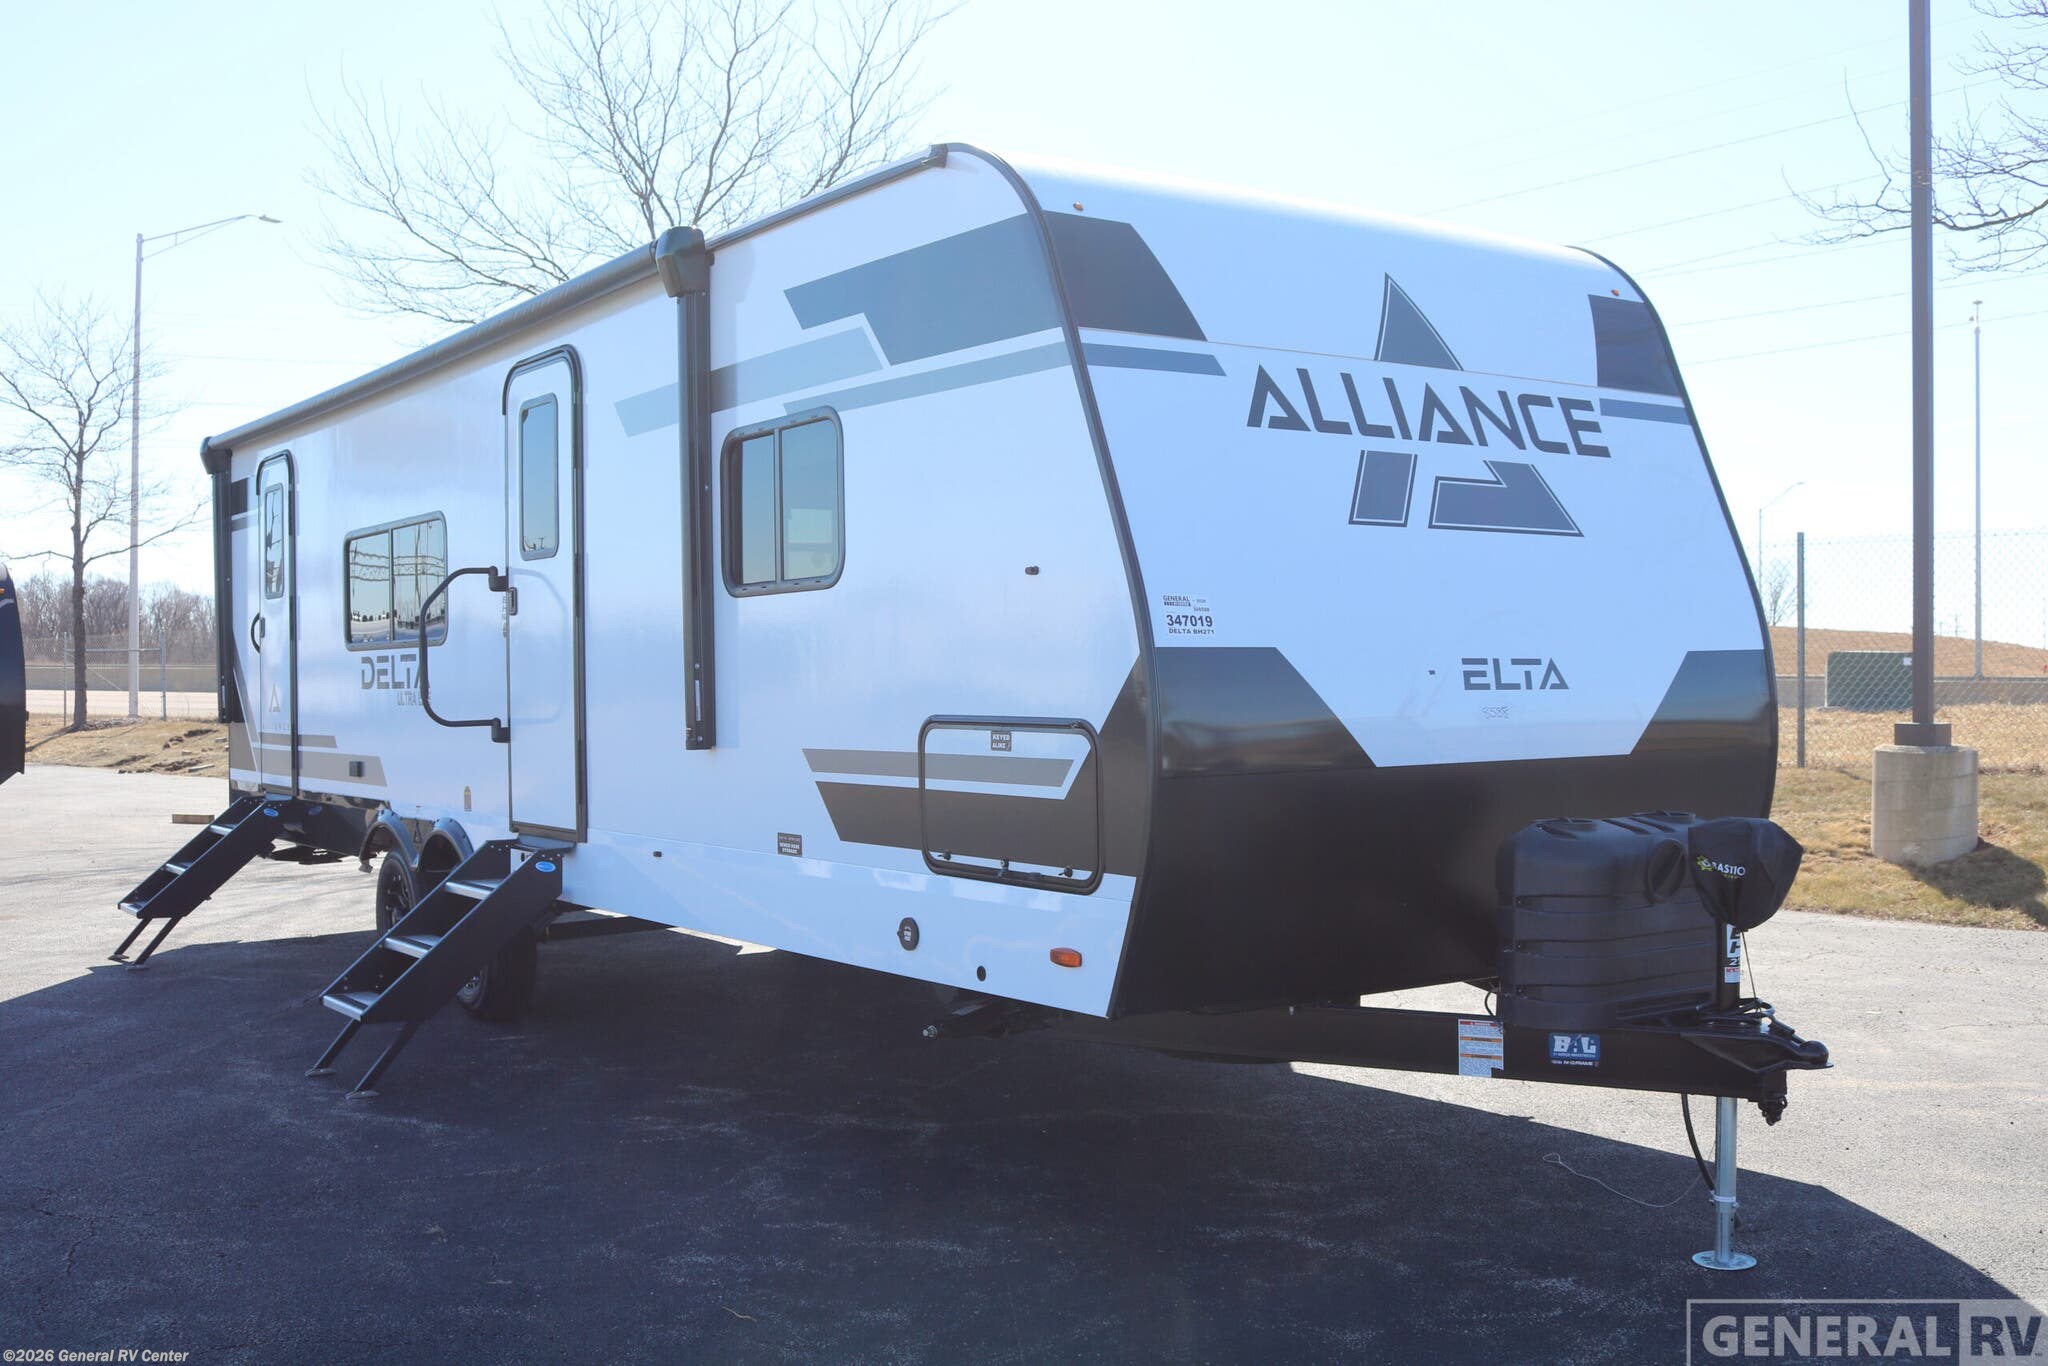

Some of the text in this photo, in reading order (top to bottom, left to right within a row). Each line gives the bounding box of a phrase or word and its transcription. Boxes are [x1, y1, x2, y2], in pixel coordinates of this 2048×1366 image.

[1247, 364, 1611, 458] ALLIANCE
[1166, 614, 1213, 627] 347019
[1461, 657, 1569, 690] ELTA
